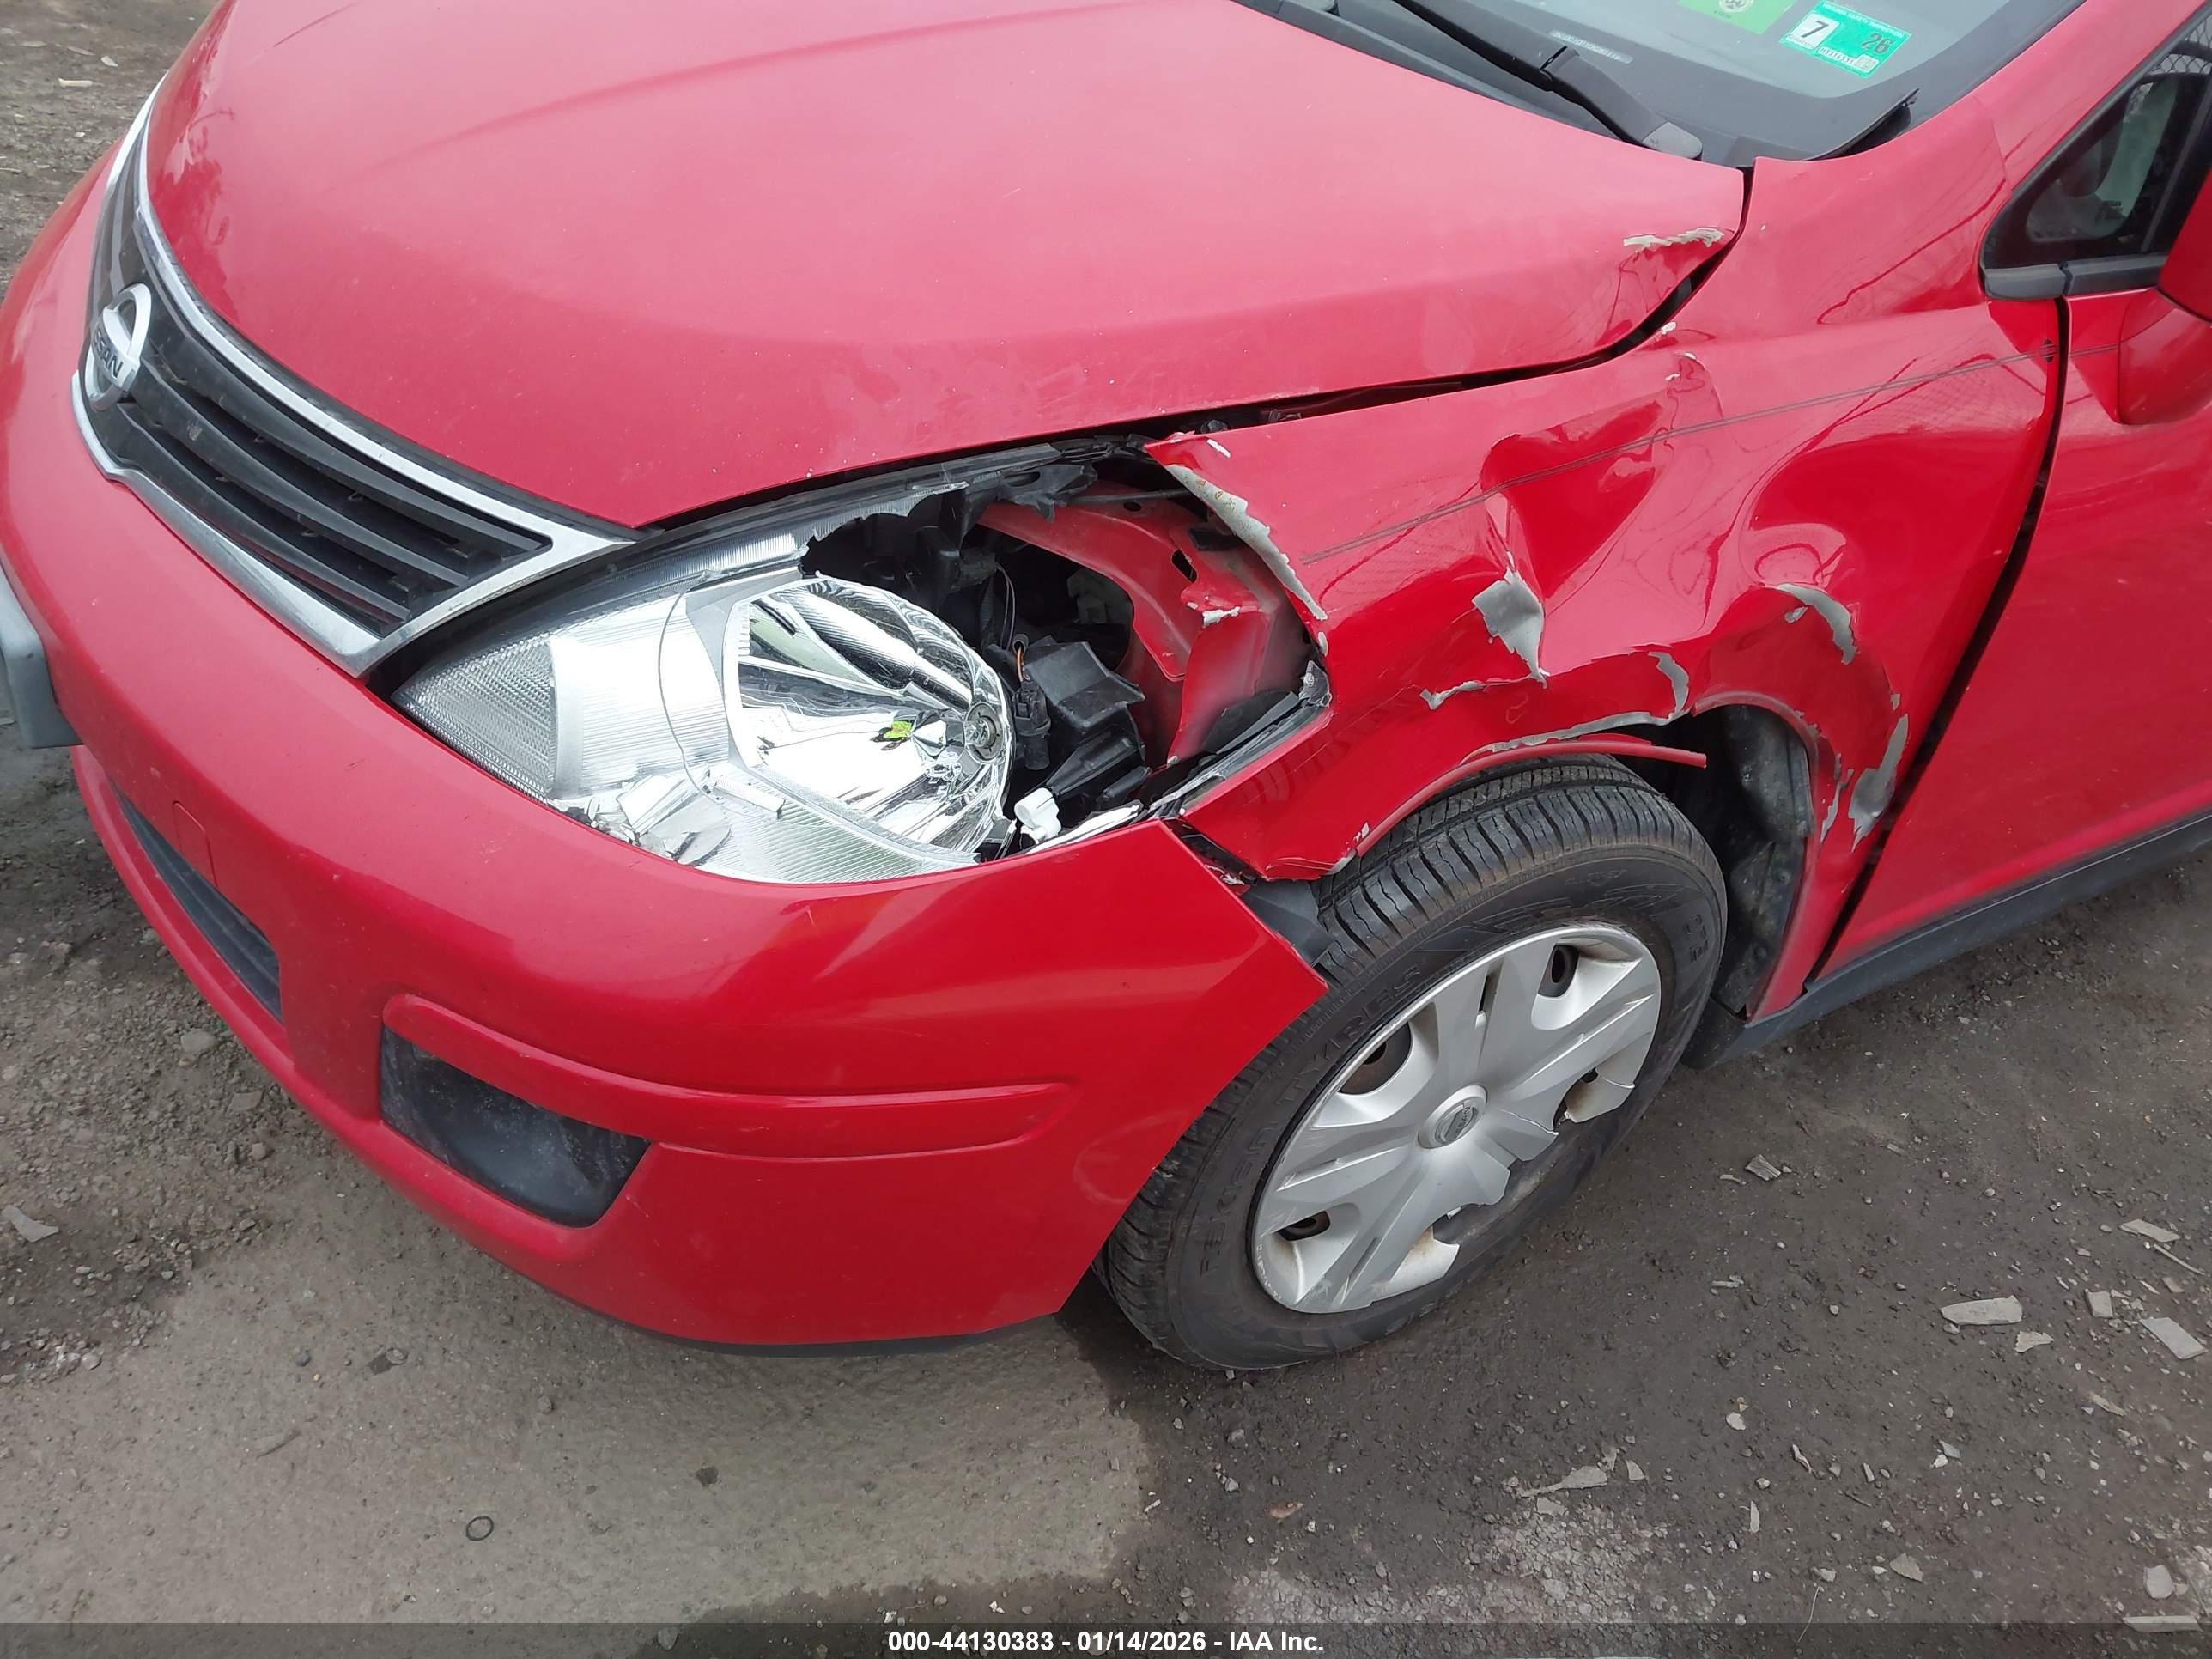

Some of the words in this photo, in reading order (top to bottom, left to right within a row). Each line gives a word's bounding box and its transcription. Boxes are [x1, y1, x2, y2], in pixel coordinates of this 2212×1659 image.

[1800, 19, 1830, 39] 7
[1859, 32, 1895, 56] 26
[94, 326, 125, 380] SSAN
